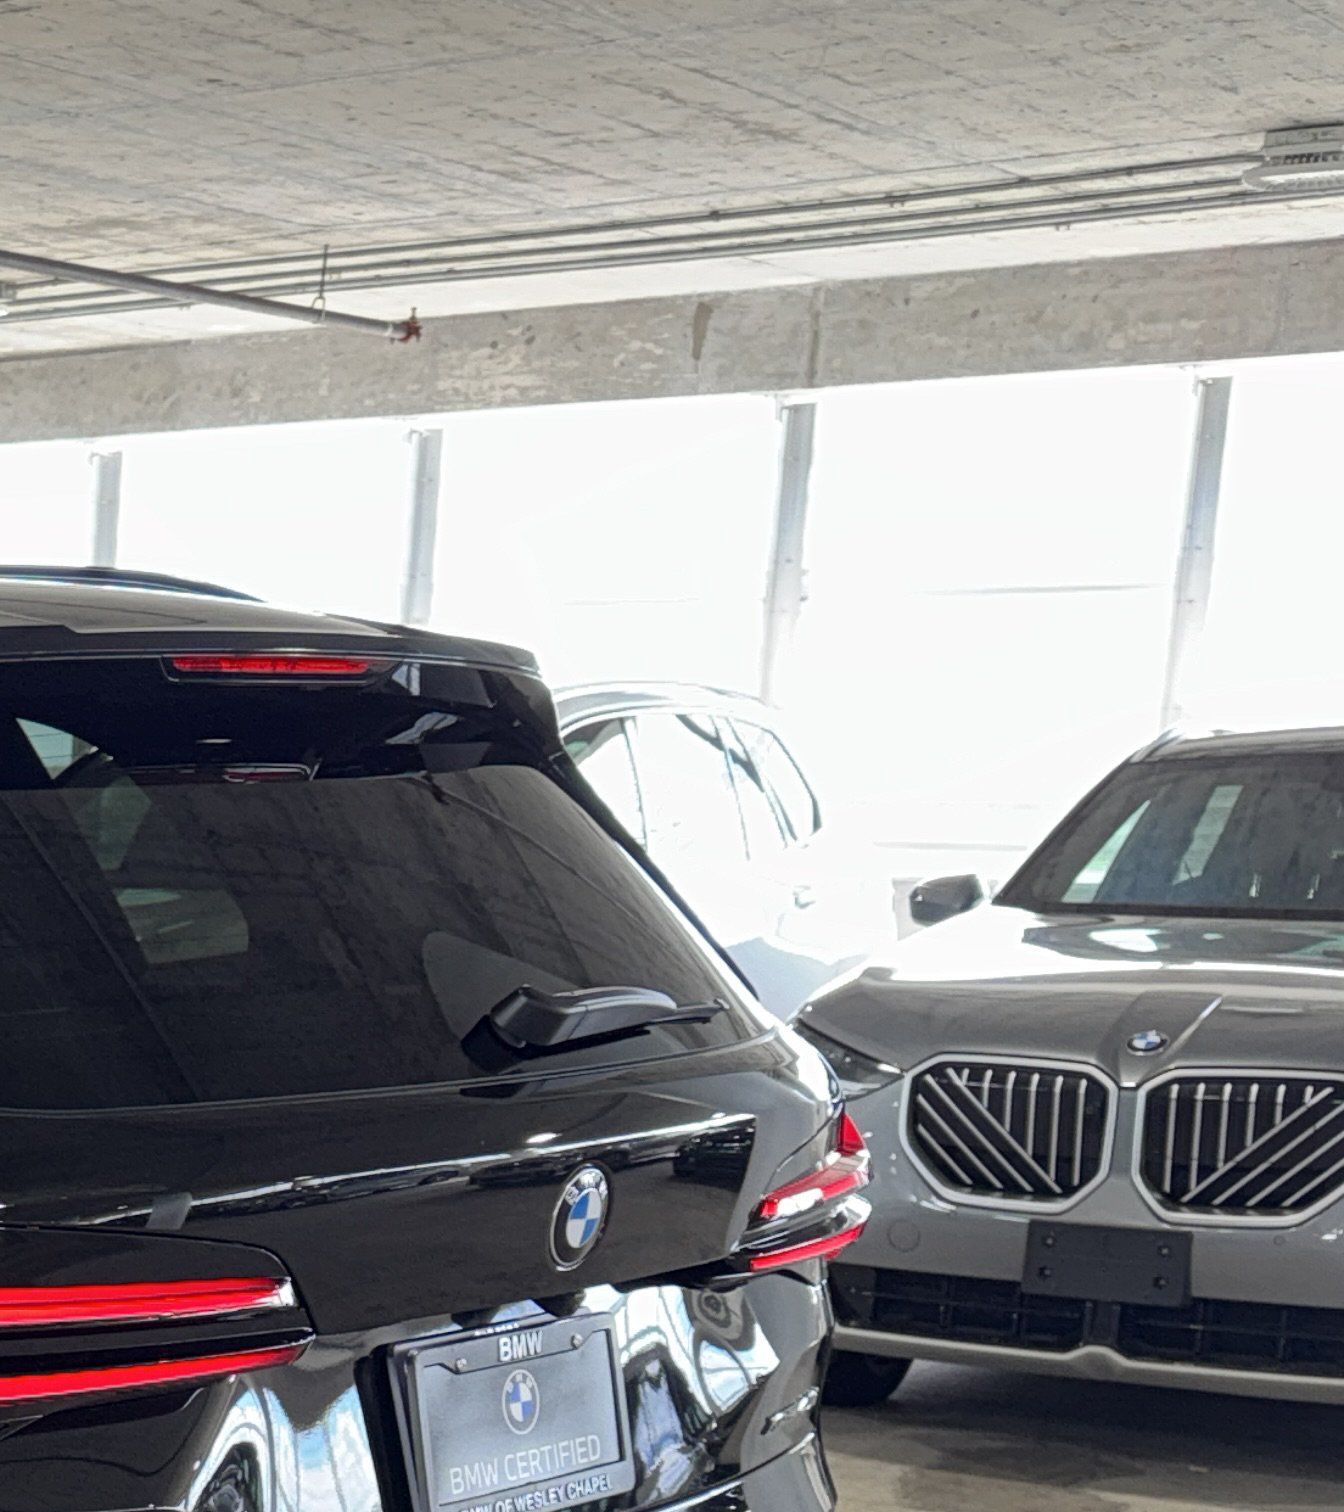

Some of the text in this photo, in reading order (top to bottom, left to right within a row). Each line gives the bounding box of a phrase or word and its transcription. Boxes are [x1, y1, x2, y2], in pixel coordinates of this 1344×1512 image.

[499, 1330, 543, 1362] BMW
[449, 1434, 601, 1495] BMW CERTIFIED
[514, 1485, 564, 1512] WESLEY
